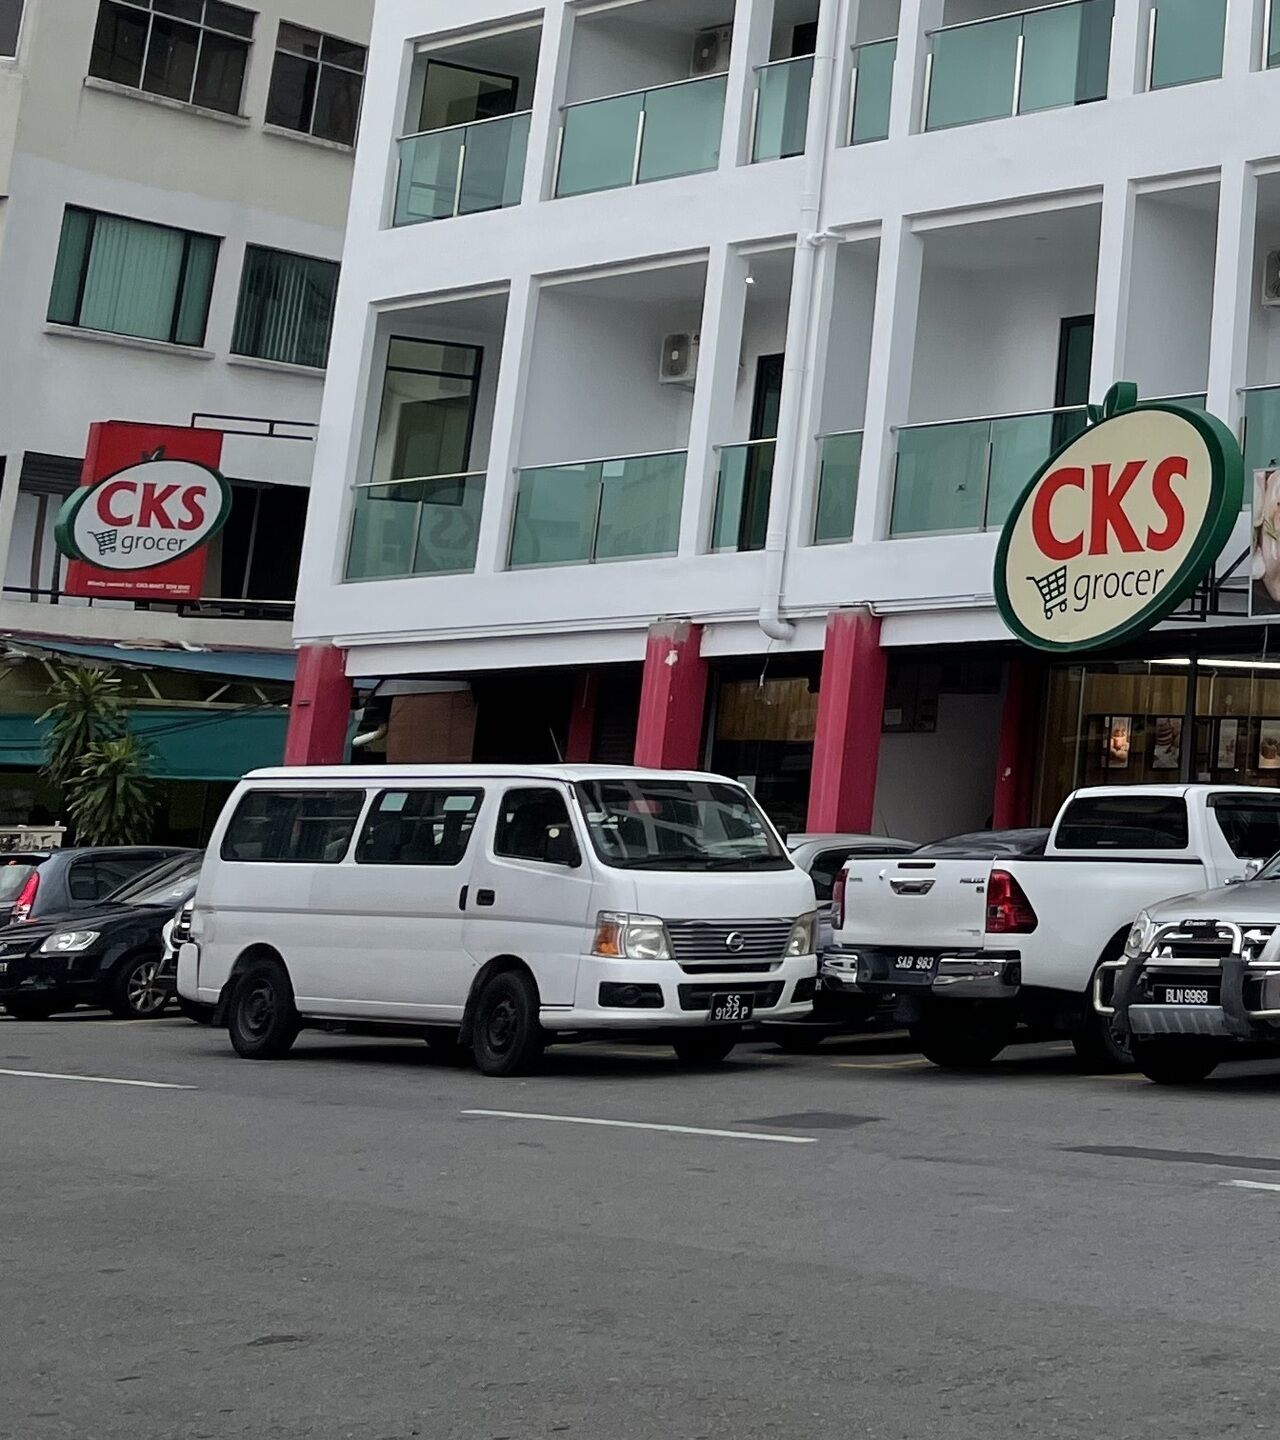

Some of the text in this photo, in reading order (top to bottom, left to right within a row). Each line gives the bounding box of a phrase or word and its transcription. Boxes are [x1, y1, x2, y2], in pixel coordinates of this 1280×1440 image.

[97, 480, 207, 531] CKS
[1032, 456, 1188, 561] CKS
[121, 534, 187, 554] grocer
[1073, 569, 1165, 612] grocer
[895, 956, 934, 970] SAB 983
[726, 994, 741, 1007] SS
[1165, 989, 1209, 1004] BLN 9968
[715, 1006, 740, 1020] 9122
